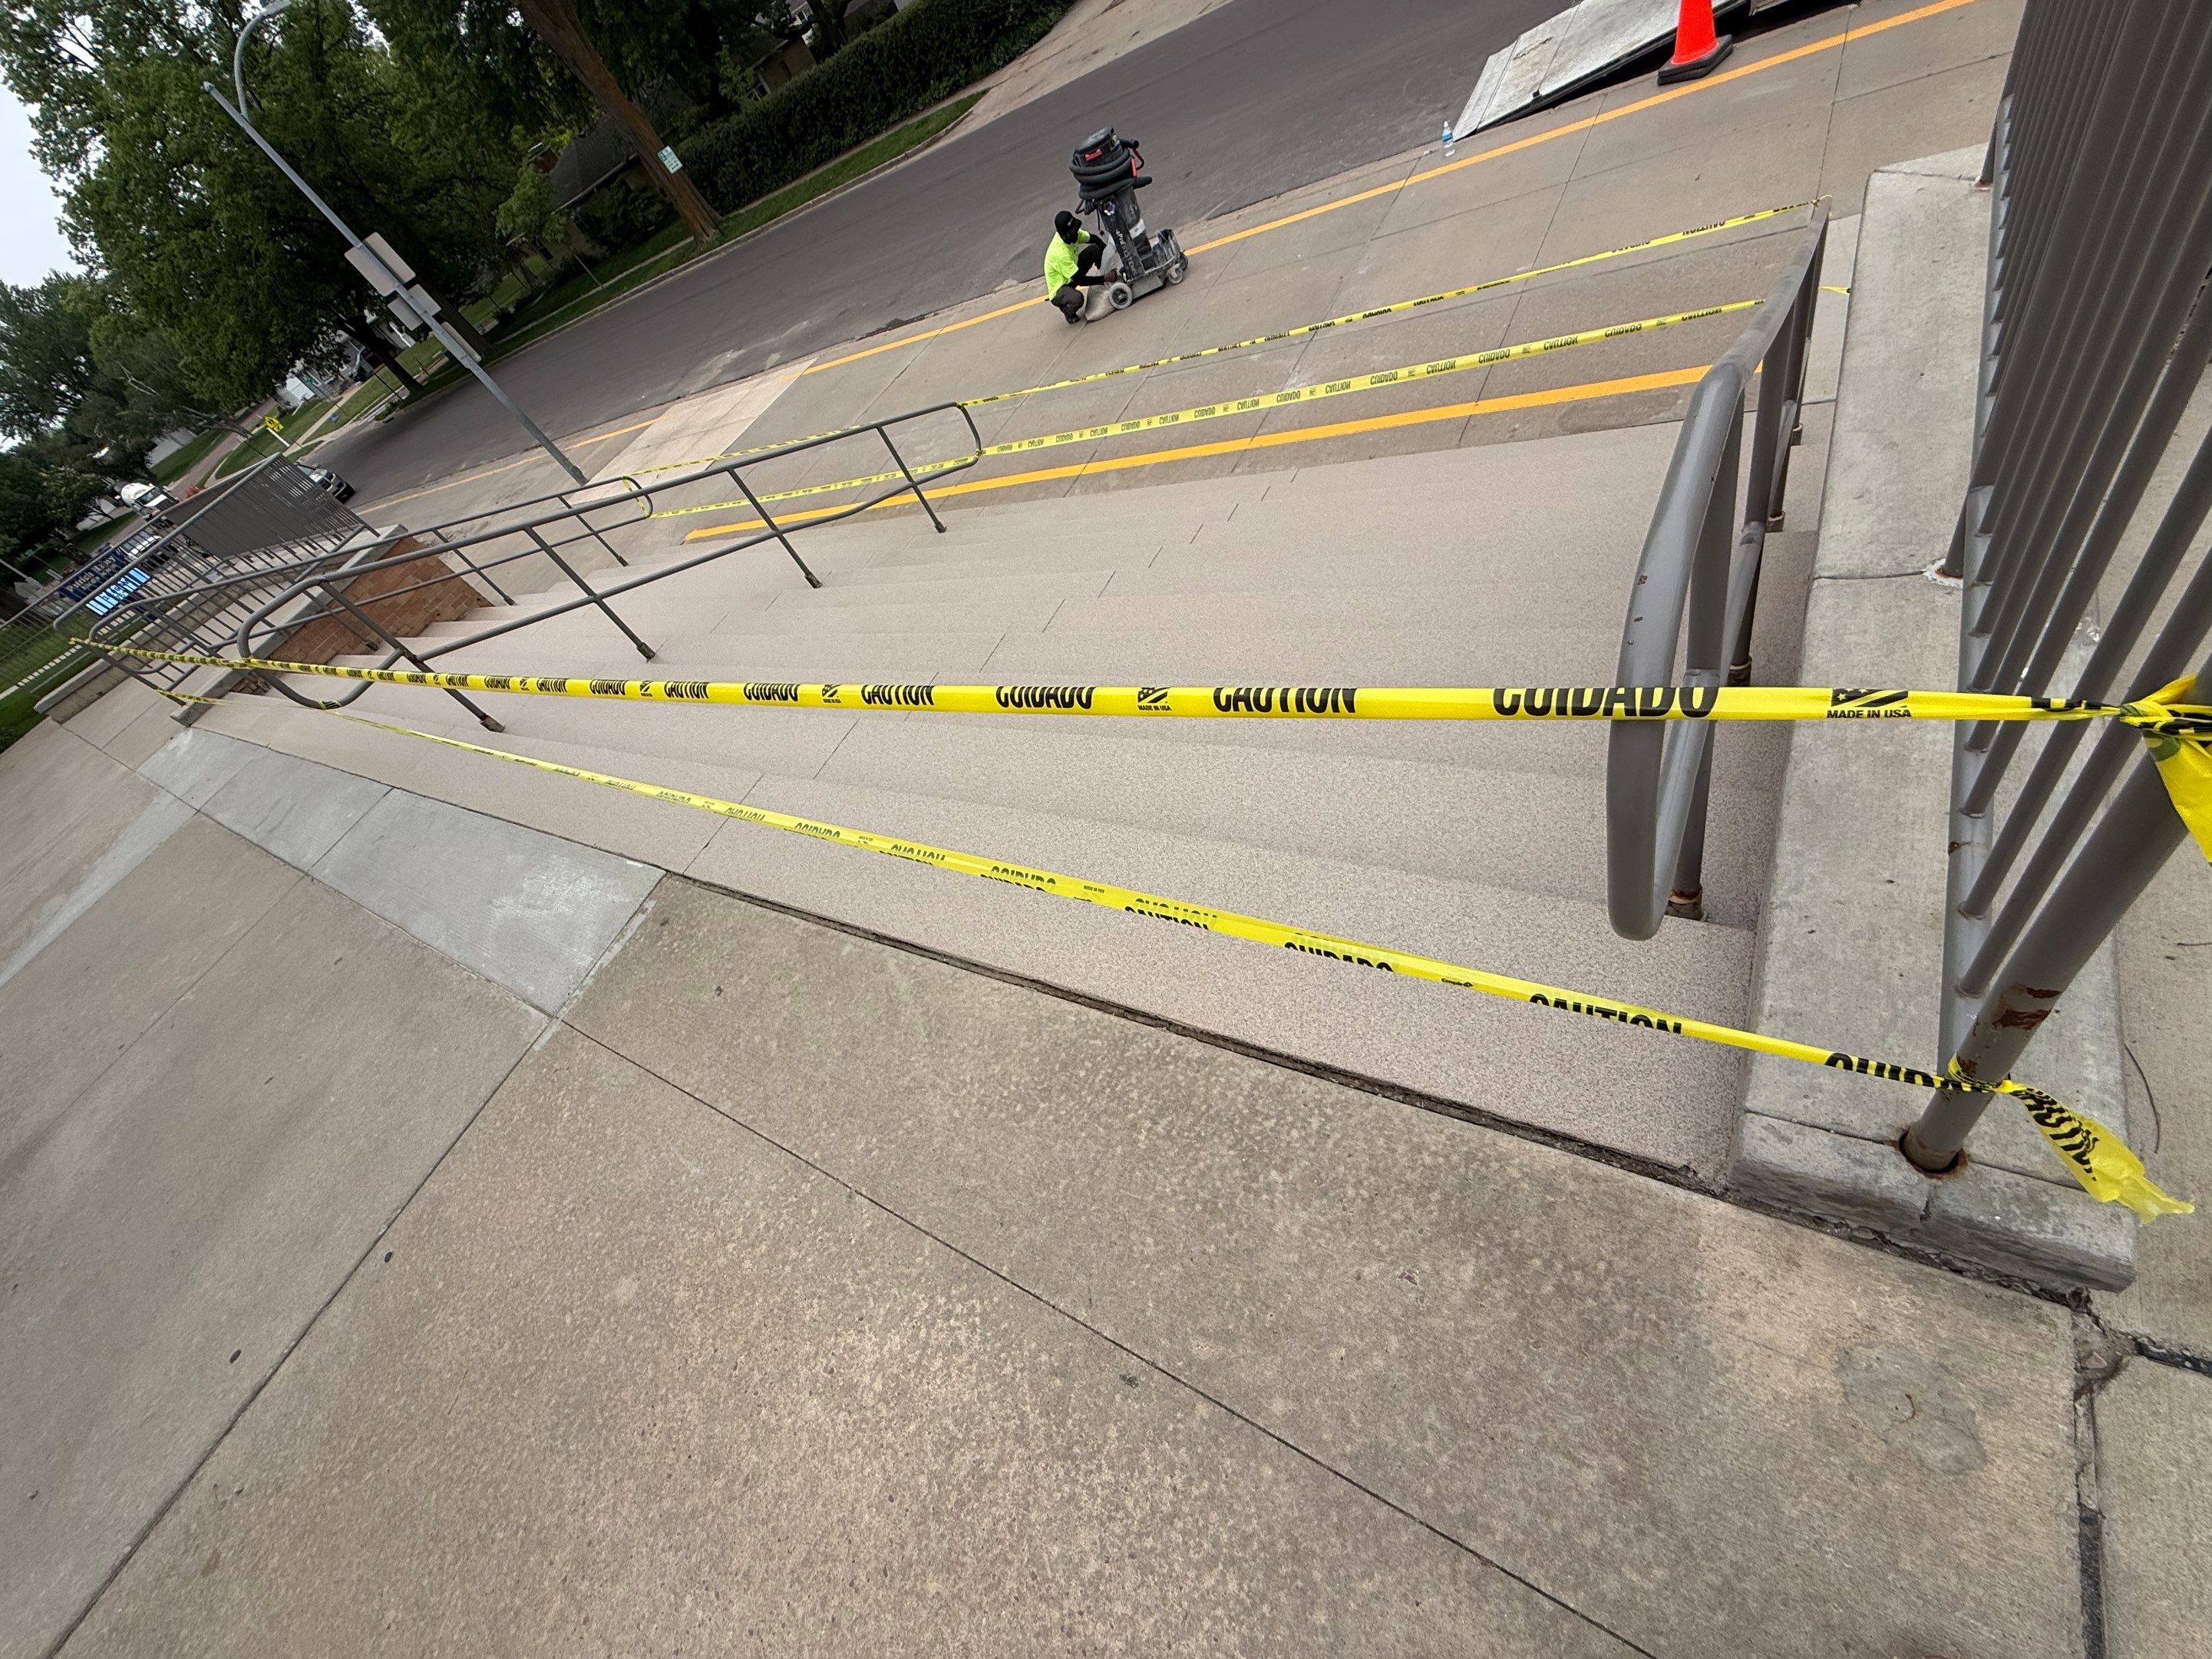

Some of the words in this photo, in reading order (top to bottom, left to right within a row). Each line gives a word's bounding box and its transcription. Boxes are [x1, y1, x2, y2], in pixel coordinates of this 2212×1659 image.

[1493, 687, 1720, 717] CUIDADO
[1827, 710, 1864, 718] MADE
[1867, 710, 1880, 718] IN
[1884, 710, 1912, 718] USA
